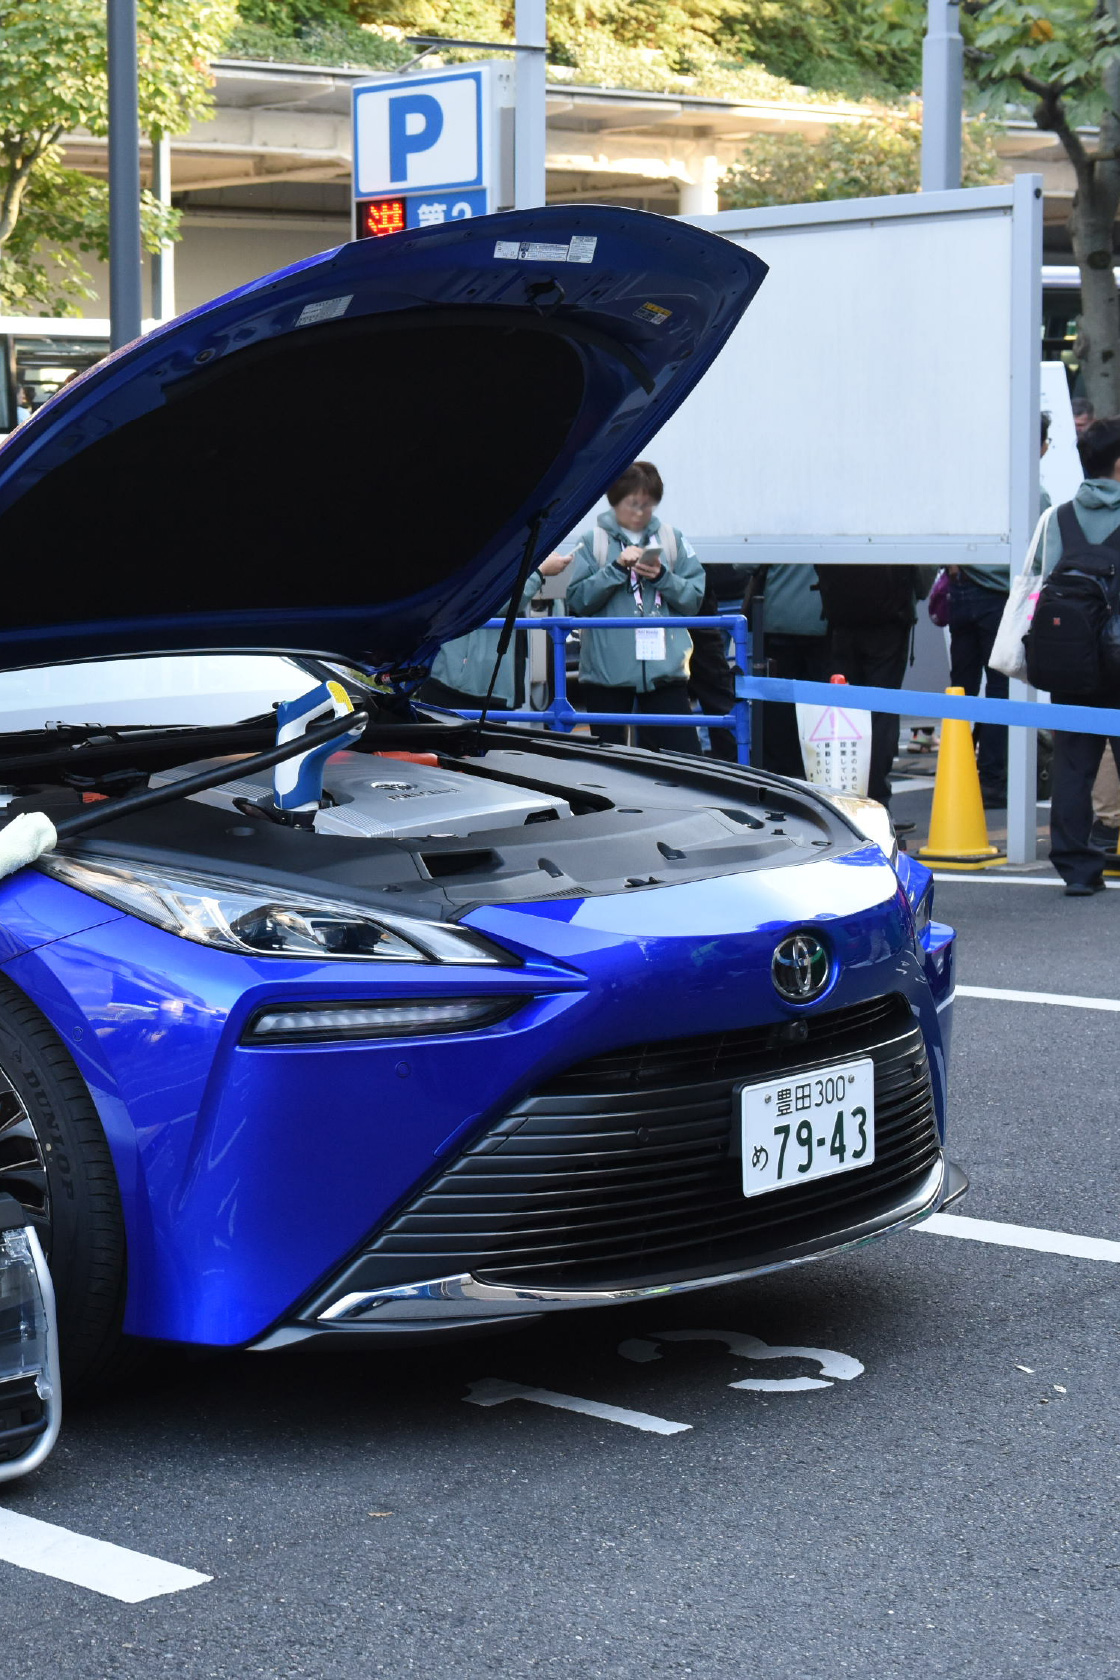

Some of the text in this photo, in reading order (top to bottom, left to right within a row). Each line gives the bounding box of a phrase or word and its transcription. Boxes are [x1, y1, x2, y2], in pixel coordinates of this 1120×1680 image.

[388, 94, 444, 183] P
[22, 1068, 75, 1201] DUNLOP
[751, 1106, 868, 1180] め 79-43
